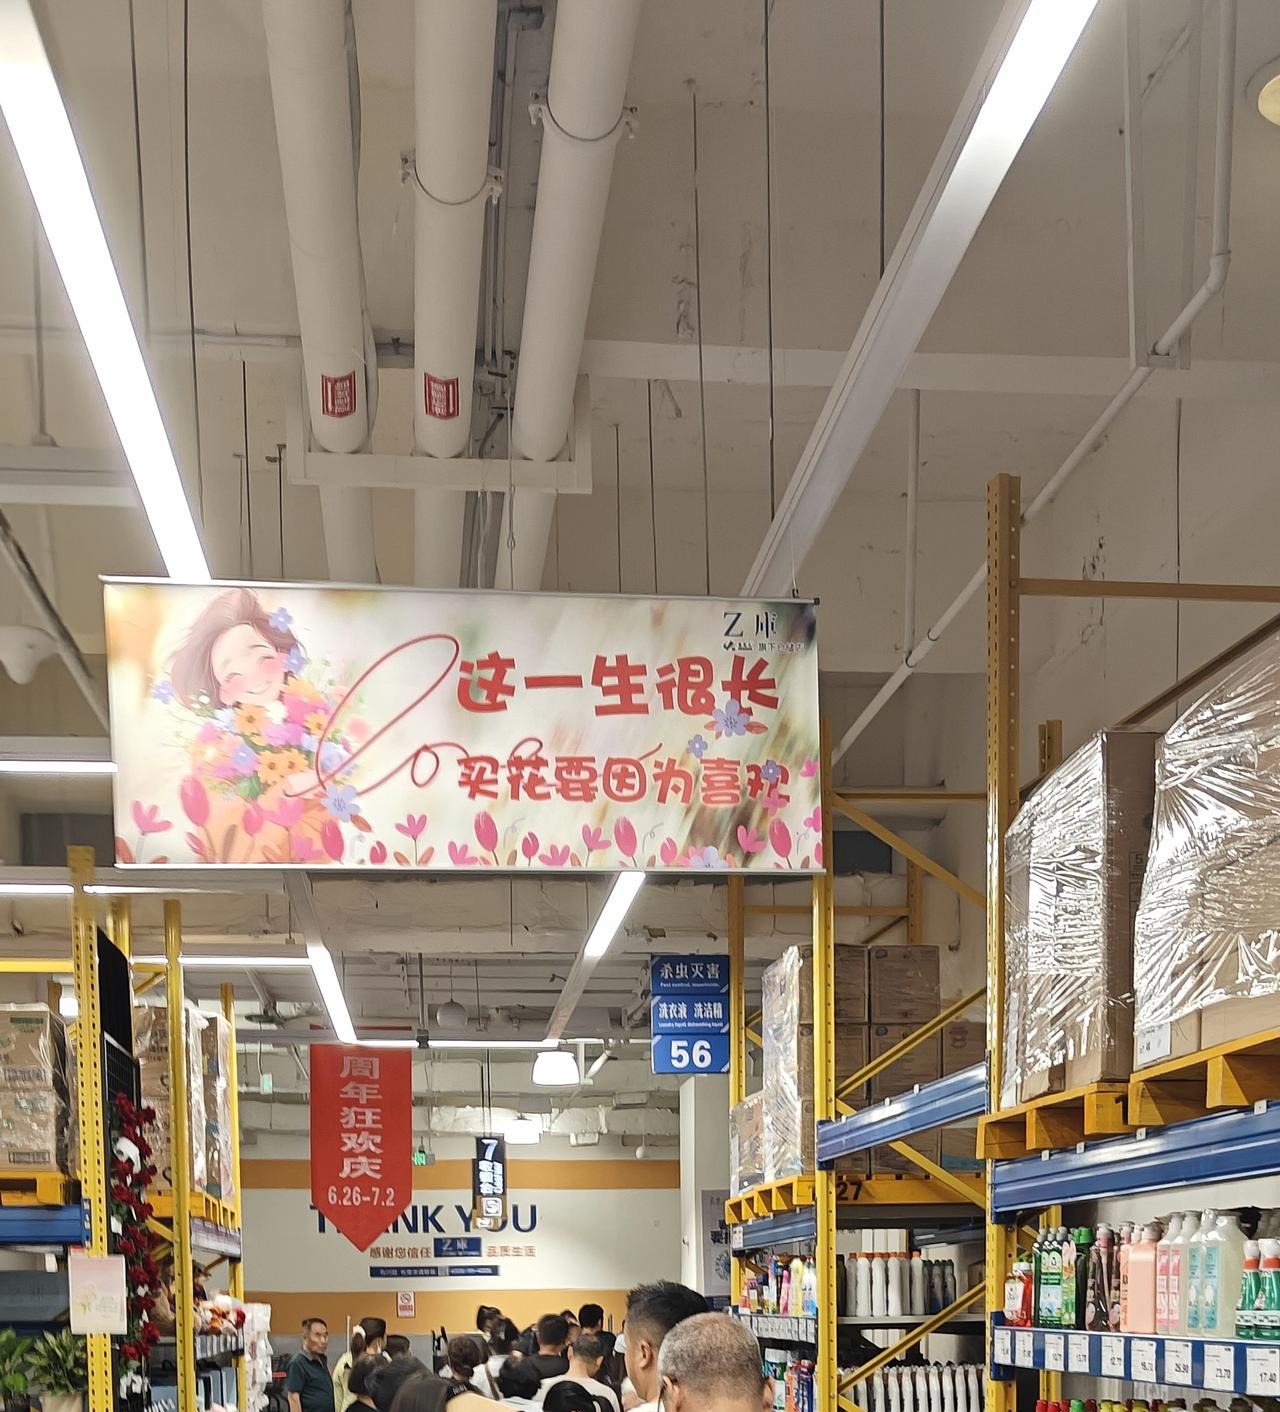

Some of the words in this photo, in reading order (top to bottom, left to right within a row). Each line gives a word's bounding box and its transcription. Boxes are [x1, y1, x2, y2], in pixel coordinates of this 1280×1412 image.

[457, 652, 780, 718] 这一生很长
[457, 756, 791, 808] 买花要因为喜欢
[660, 962, 720, 979] 杀虫灭害
[659, 1002, 688, 1019] 洗衣液
[694, 1002, 722, 1019] 洗洁精
[671, 1040, 712, 1068] 56
[339, 1055, 383, 1180] 周年狂欢庆
[481, 1139, 498, 1160] 7
[328, 1185, 395, 1206] 6.26-7.2
[310, 1204, 446, 1233] TNK
[370, 1246, 432, 1260] 感谢您信任
